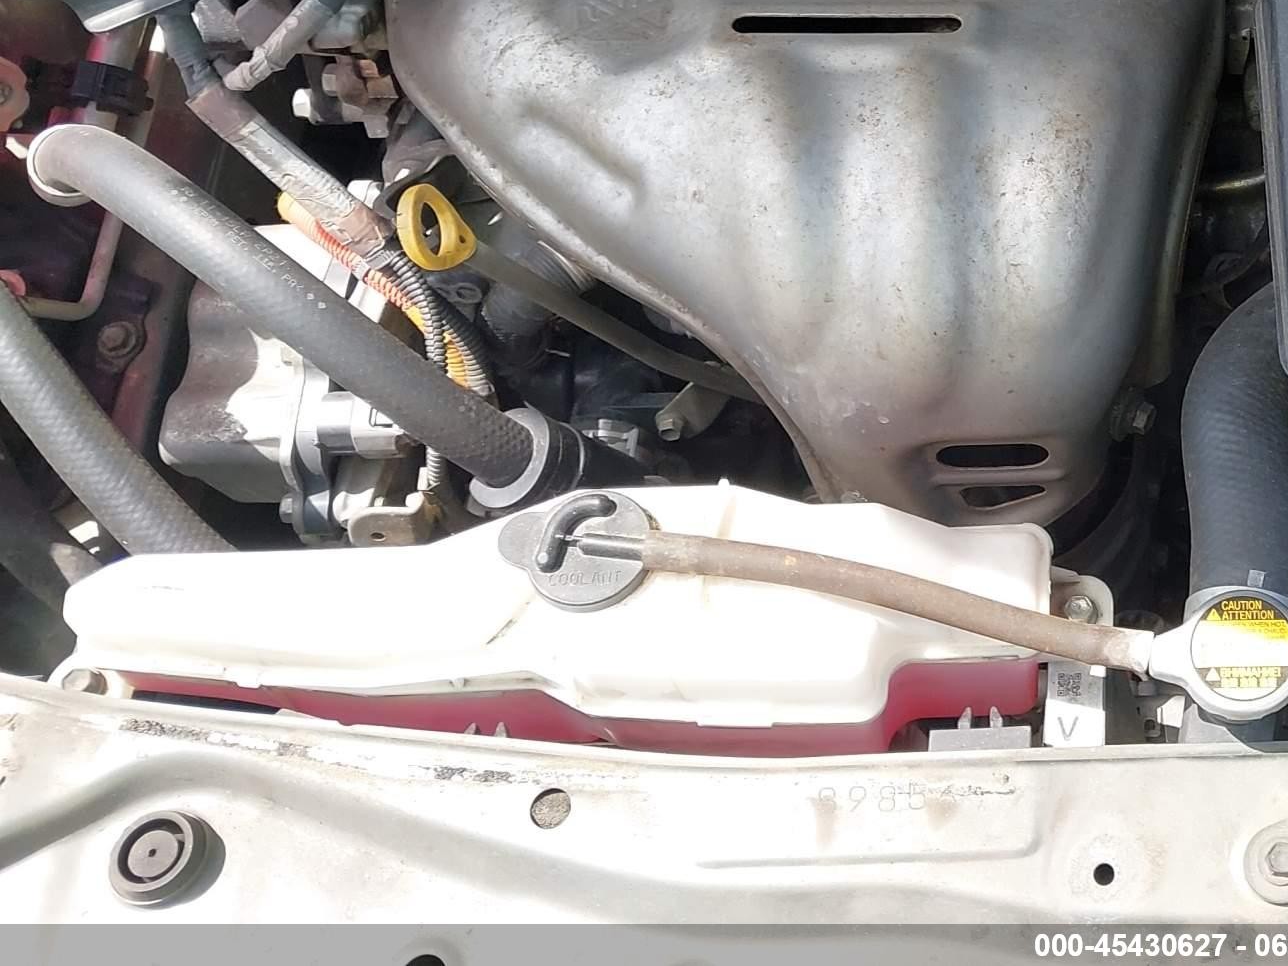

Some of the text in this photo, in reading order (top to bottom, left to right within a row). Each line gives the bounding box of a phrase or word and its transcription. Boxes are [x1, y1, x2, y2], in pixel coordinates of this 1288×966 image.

[547, 569, 622, 587] COOLANT
[1221, 600, 1262, 611] CAUTION
[1222, 610, 1275, 620] ATTENTION
[1057, 716, 1080, 742] V
